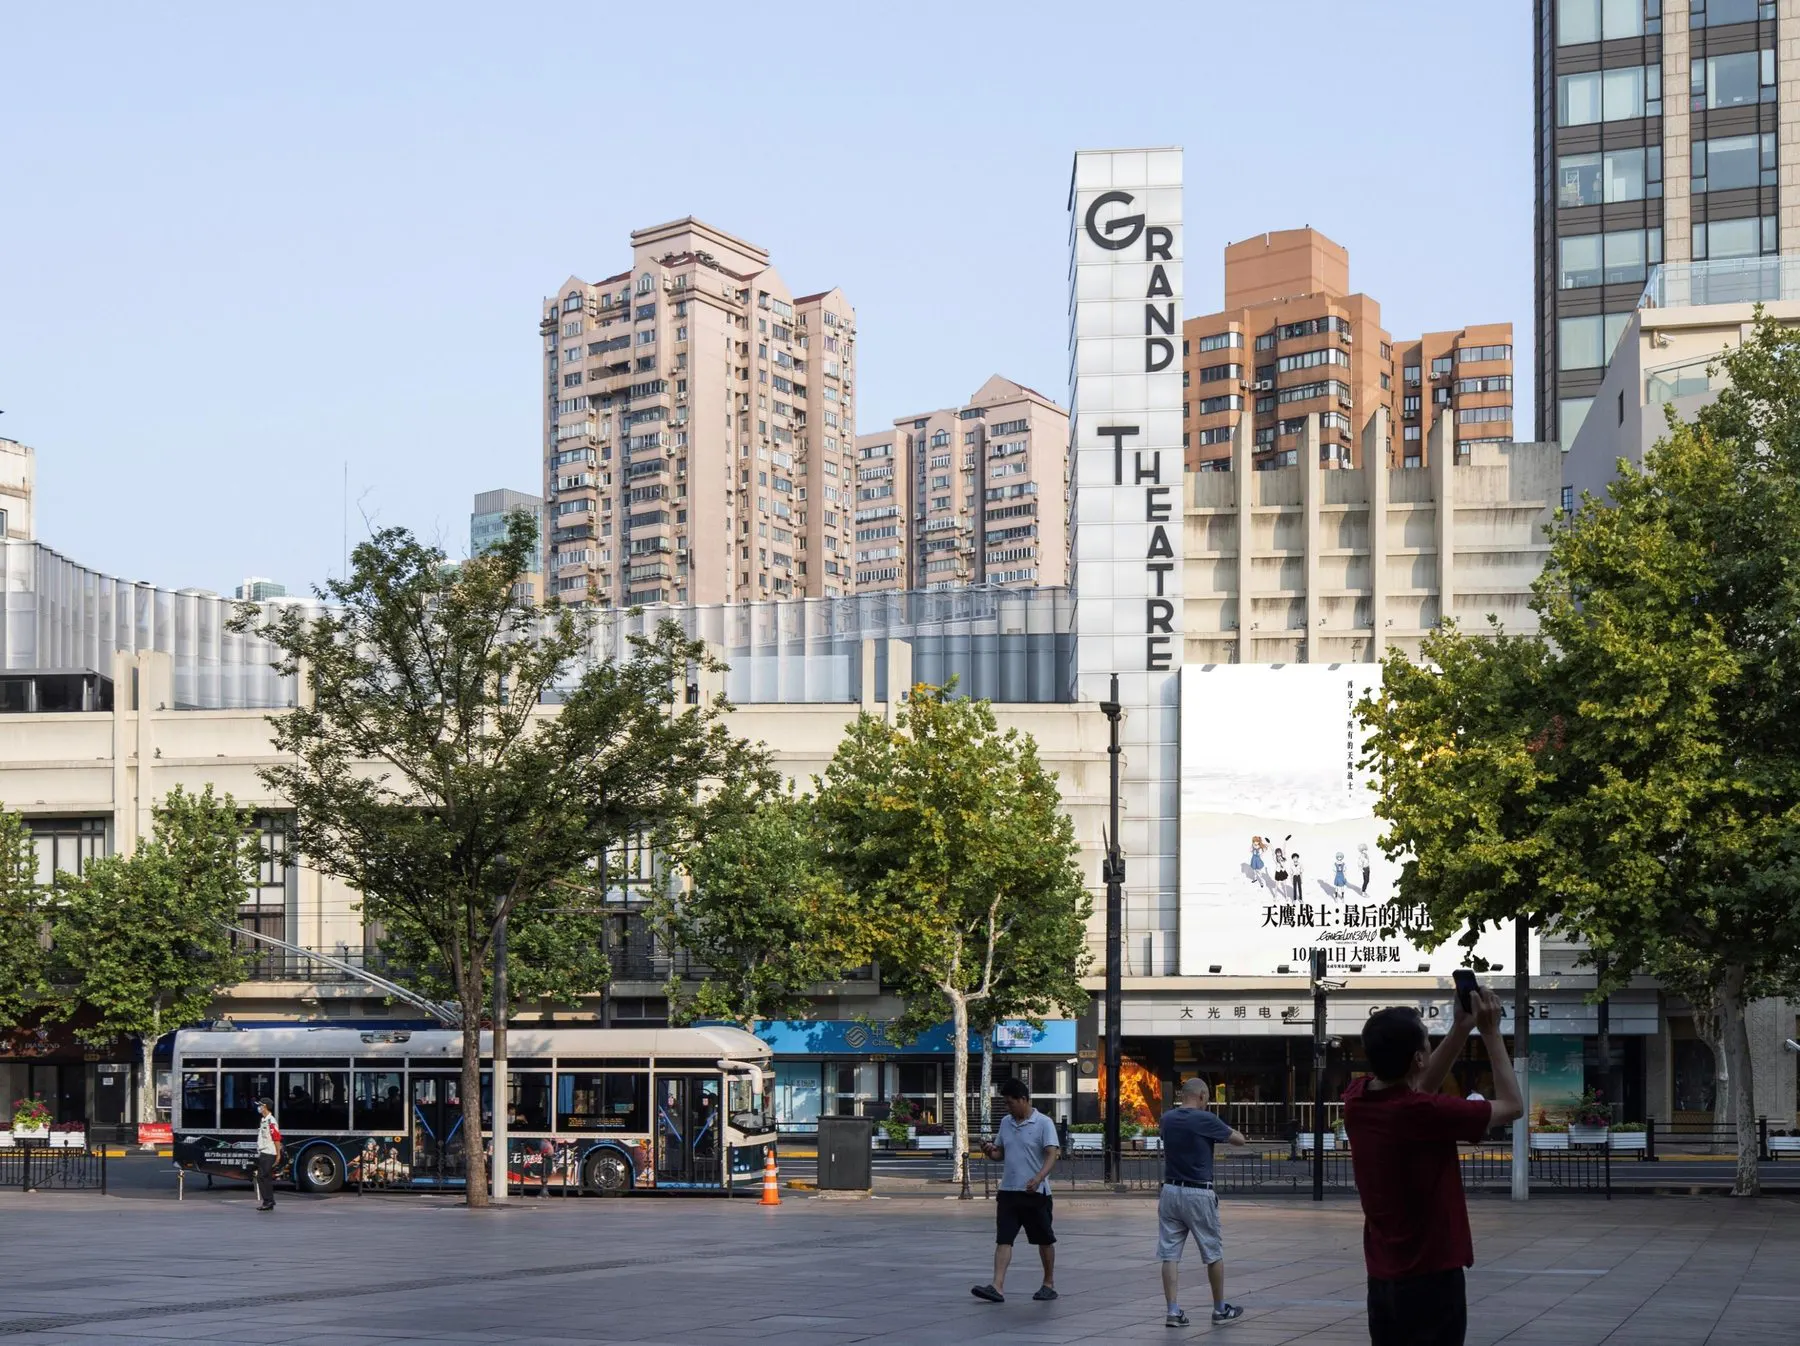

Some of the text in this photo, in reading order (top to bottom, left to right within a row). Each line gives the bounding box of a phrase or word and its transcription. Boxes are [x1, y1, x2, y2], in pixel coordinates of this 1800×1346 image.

[1085, 191, 1174, 373] GRAND
[1097, 426, 1174, 671] THEATRE
[1350, 946, 1400, 962] 大银幕见
